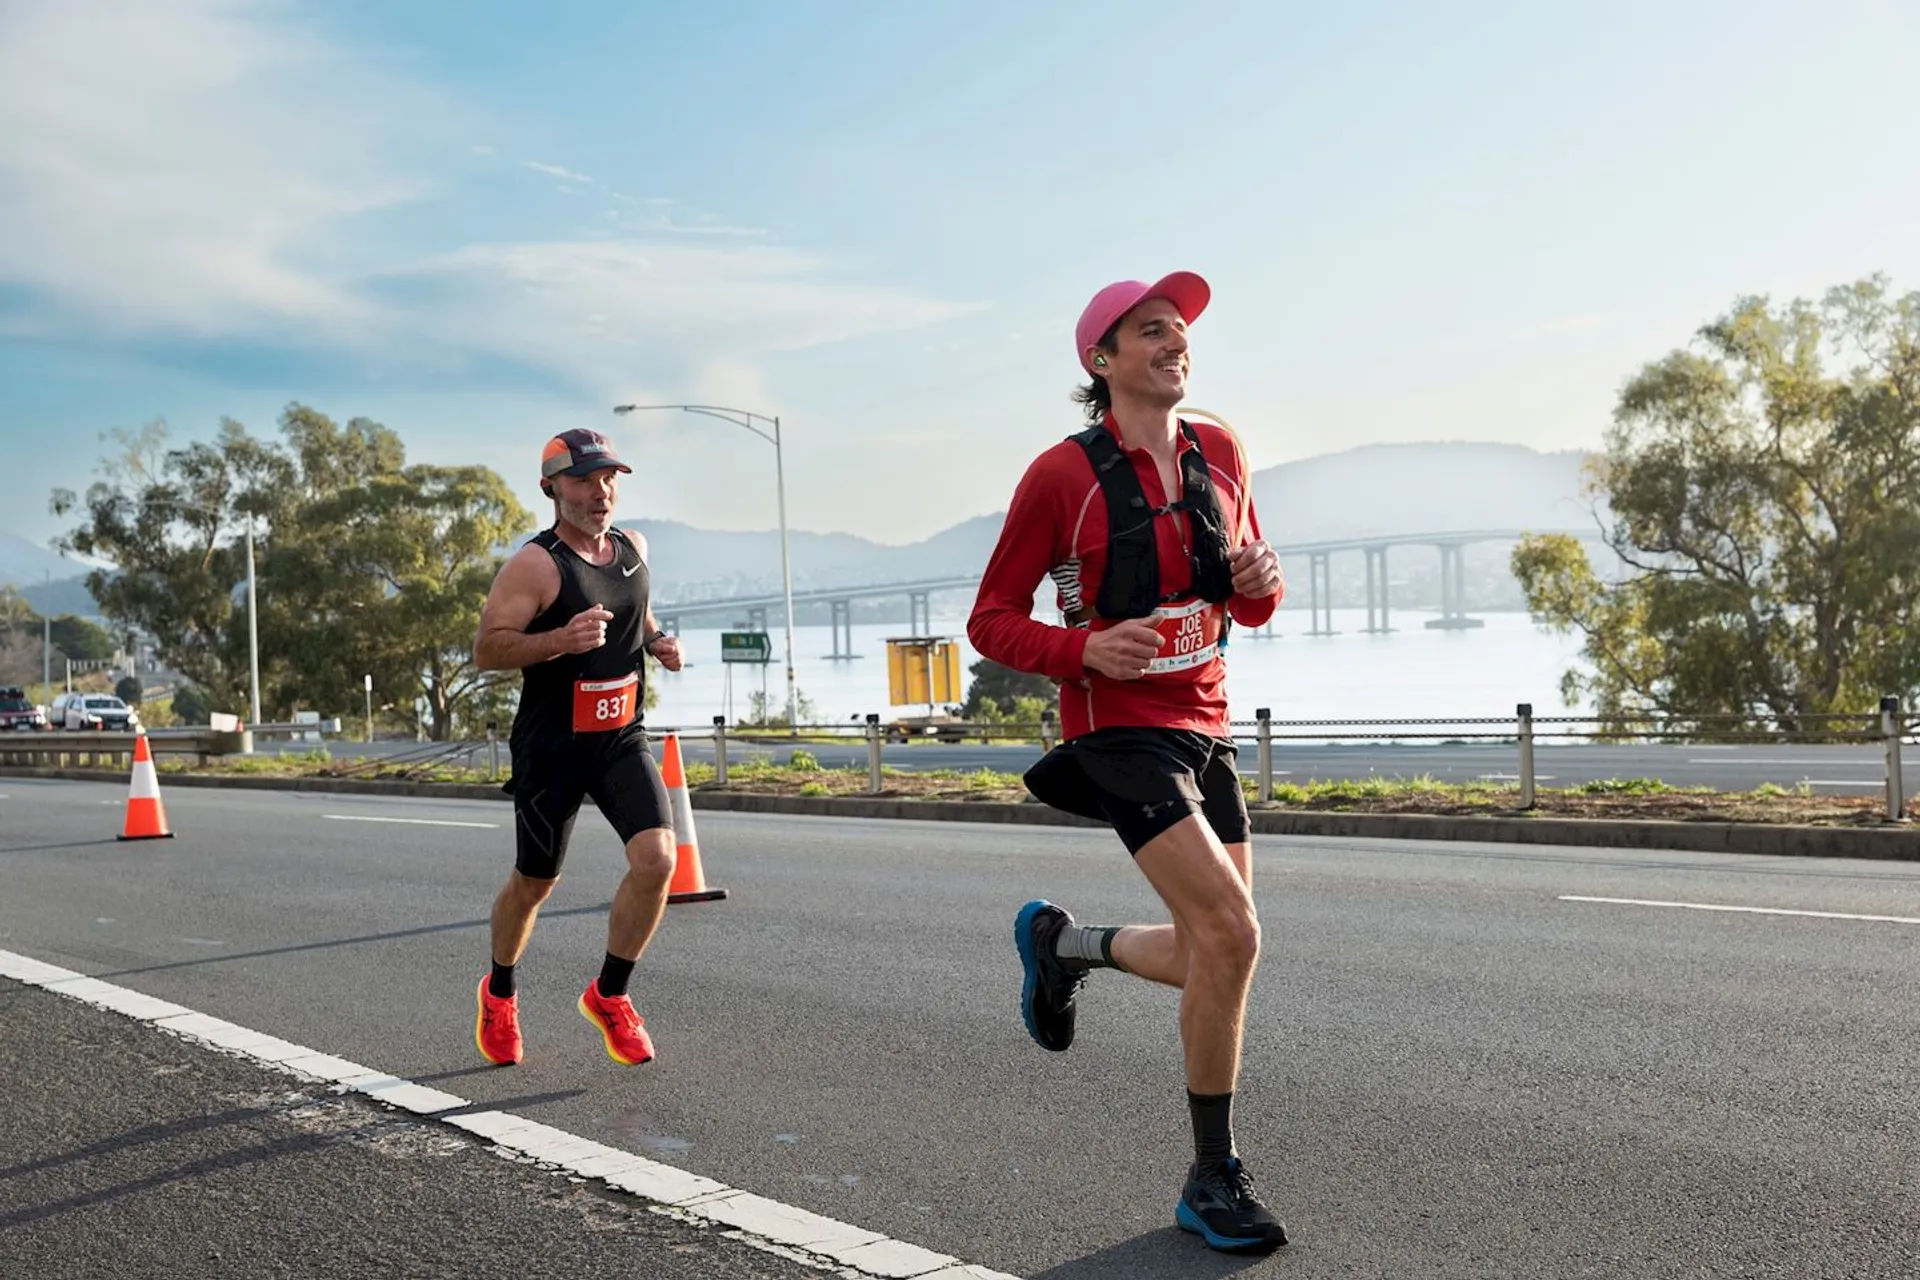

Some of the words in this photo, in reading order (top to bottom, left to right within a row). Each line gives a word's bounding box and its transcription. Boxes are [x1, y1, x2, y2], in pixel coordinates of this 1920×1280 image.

[1176, 613, 1202, 636] JOE
[1173, 631, 1204, 655] 1073
[596, 694, 629, 720] 837
